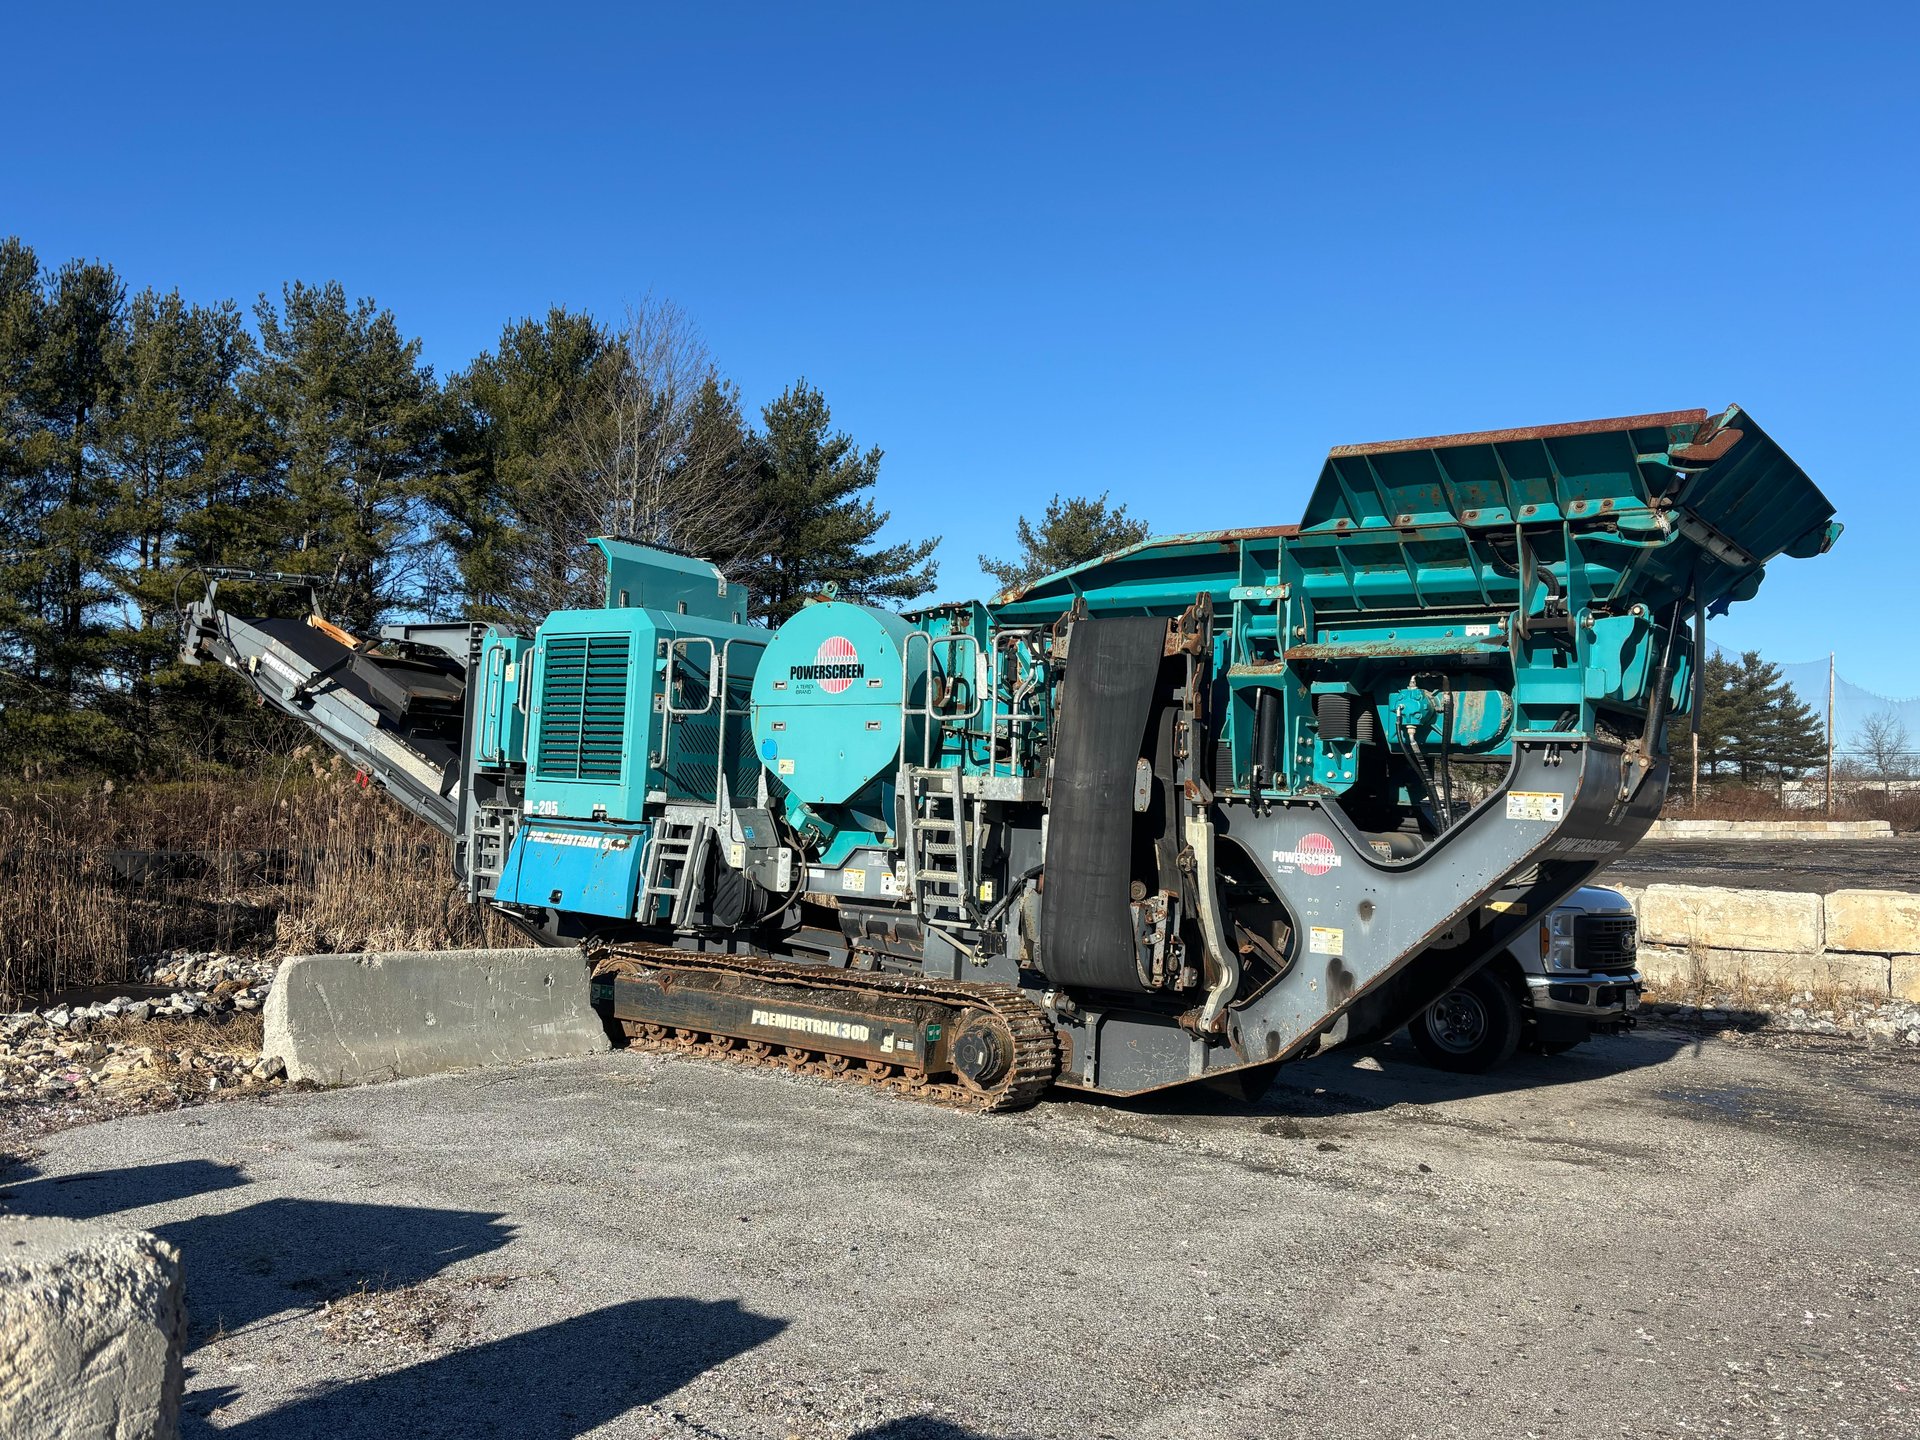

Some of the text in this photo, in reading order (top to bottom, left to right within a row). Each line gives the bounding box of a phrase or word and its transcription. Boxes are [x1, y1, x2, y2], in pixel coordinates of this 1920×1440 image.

[790, 664, 865, 680] POWERSCREEN
[1272, 850, 1342, 867] POWERSCREEN
[751, 1009, 840, 1037] PREMIERTRAK
[841, 1023, 870, 1042] 300
